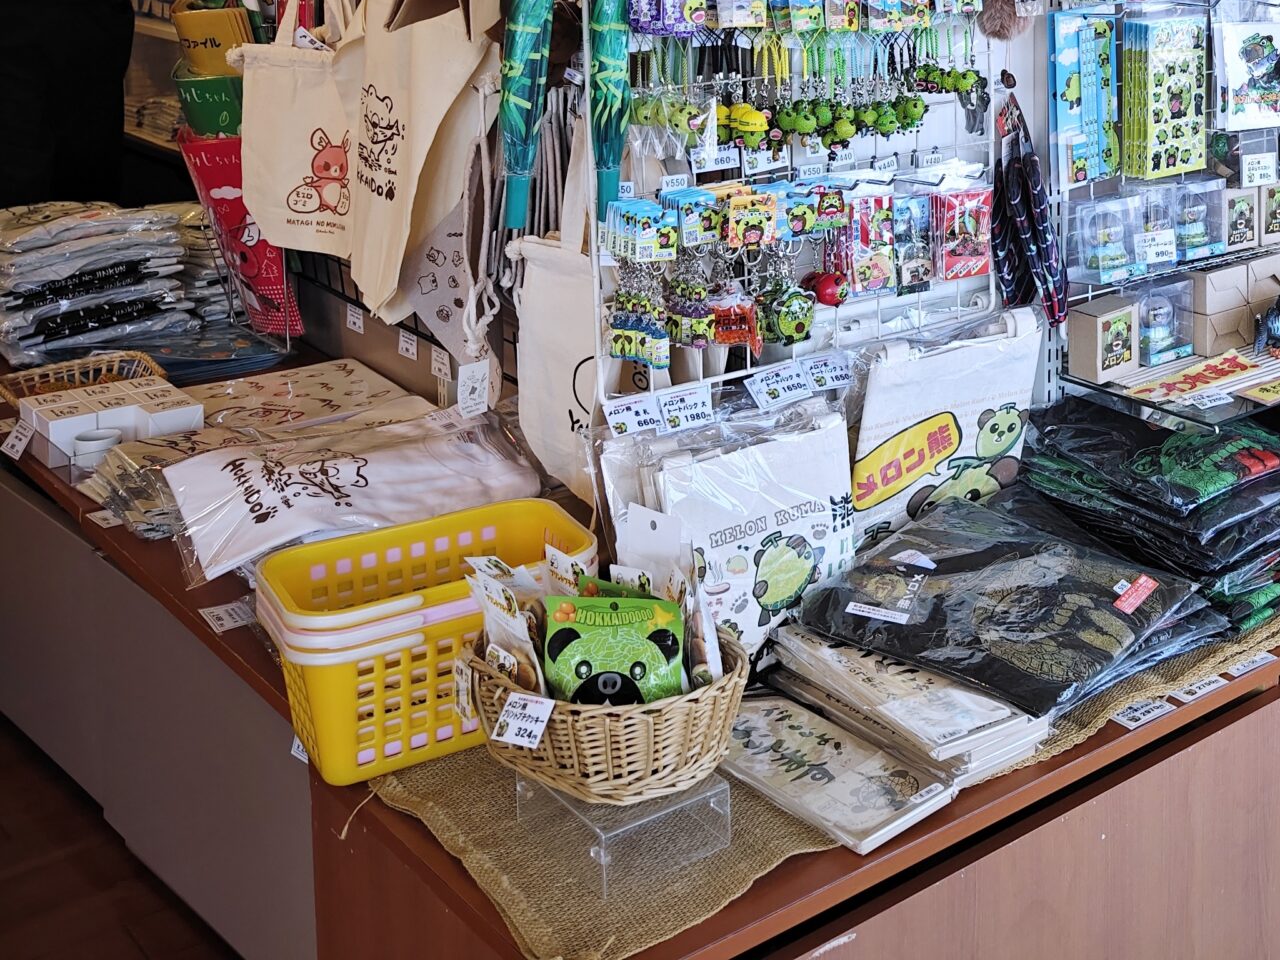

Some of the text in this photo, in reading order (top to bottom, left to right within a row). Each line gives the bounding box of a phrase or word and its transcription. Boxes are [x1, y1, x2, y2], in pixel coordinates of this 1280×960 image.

[803, 167, 821, 176] ¥550
[878, 161, 895, 172] ¥440
[665, 178, 686, 187] ¥550
[782, 383, 806, 393] 1650円
[663, 398, 686, 408] メロン熊
[685, 412, 711, 422] 1980円
[637, 418, 660, 427] 660円
[855, 423, 953, 504] メロン熊
[709, 501, 826, 548] MELON KUMA
[575, 607, 653, 627] HOKKAIDOOOO
[506, 701, 527, 711] メロン熊
[515, 726, 538, 740] 324円
